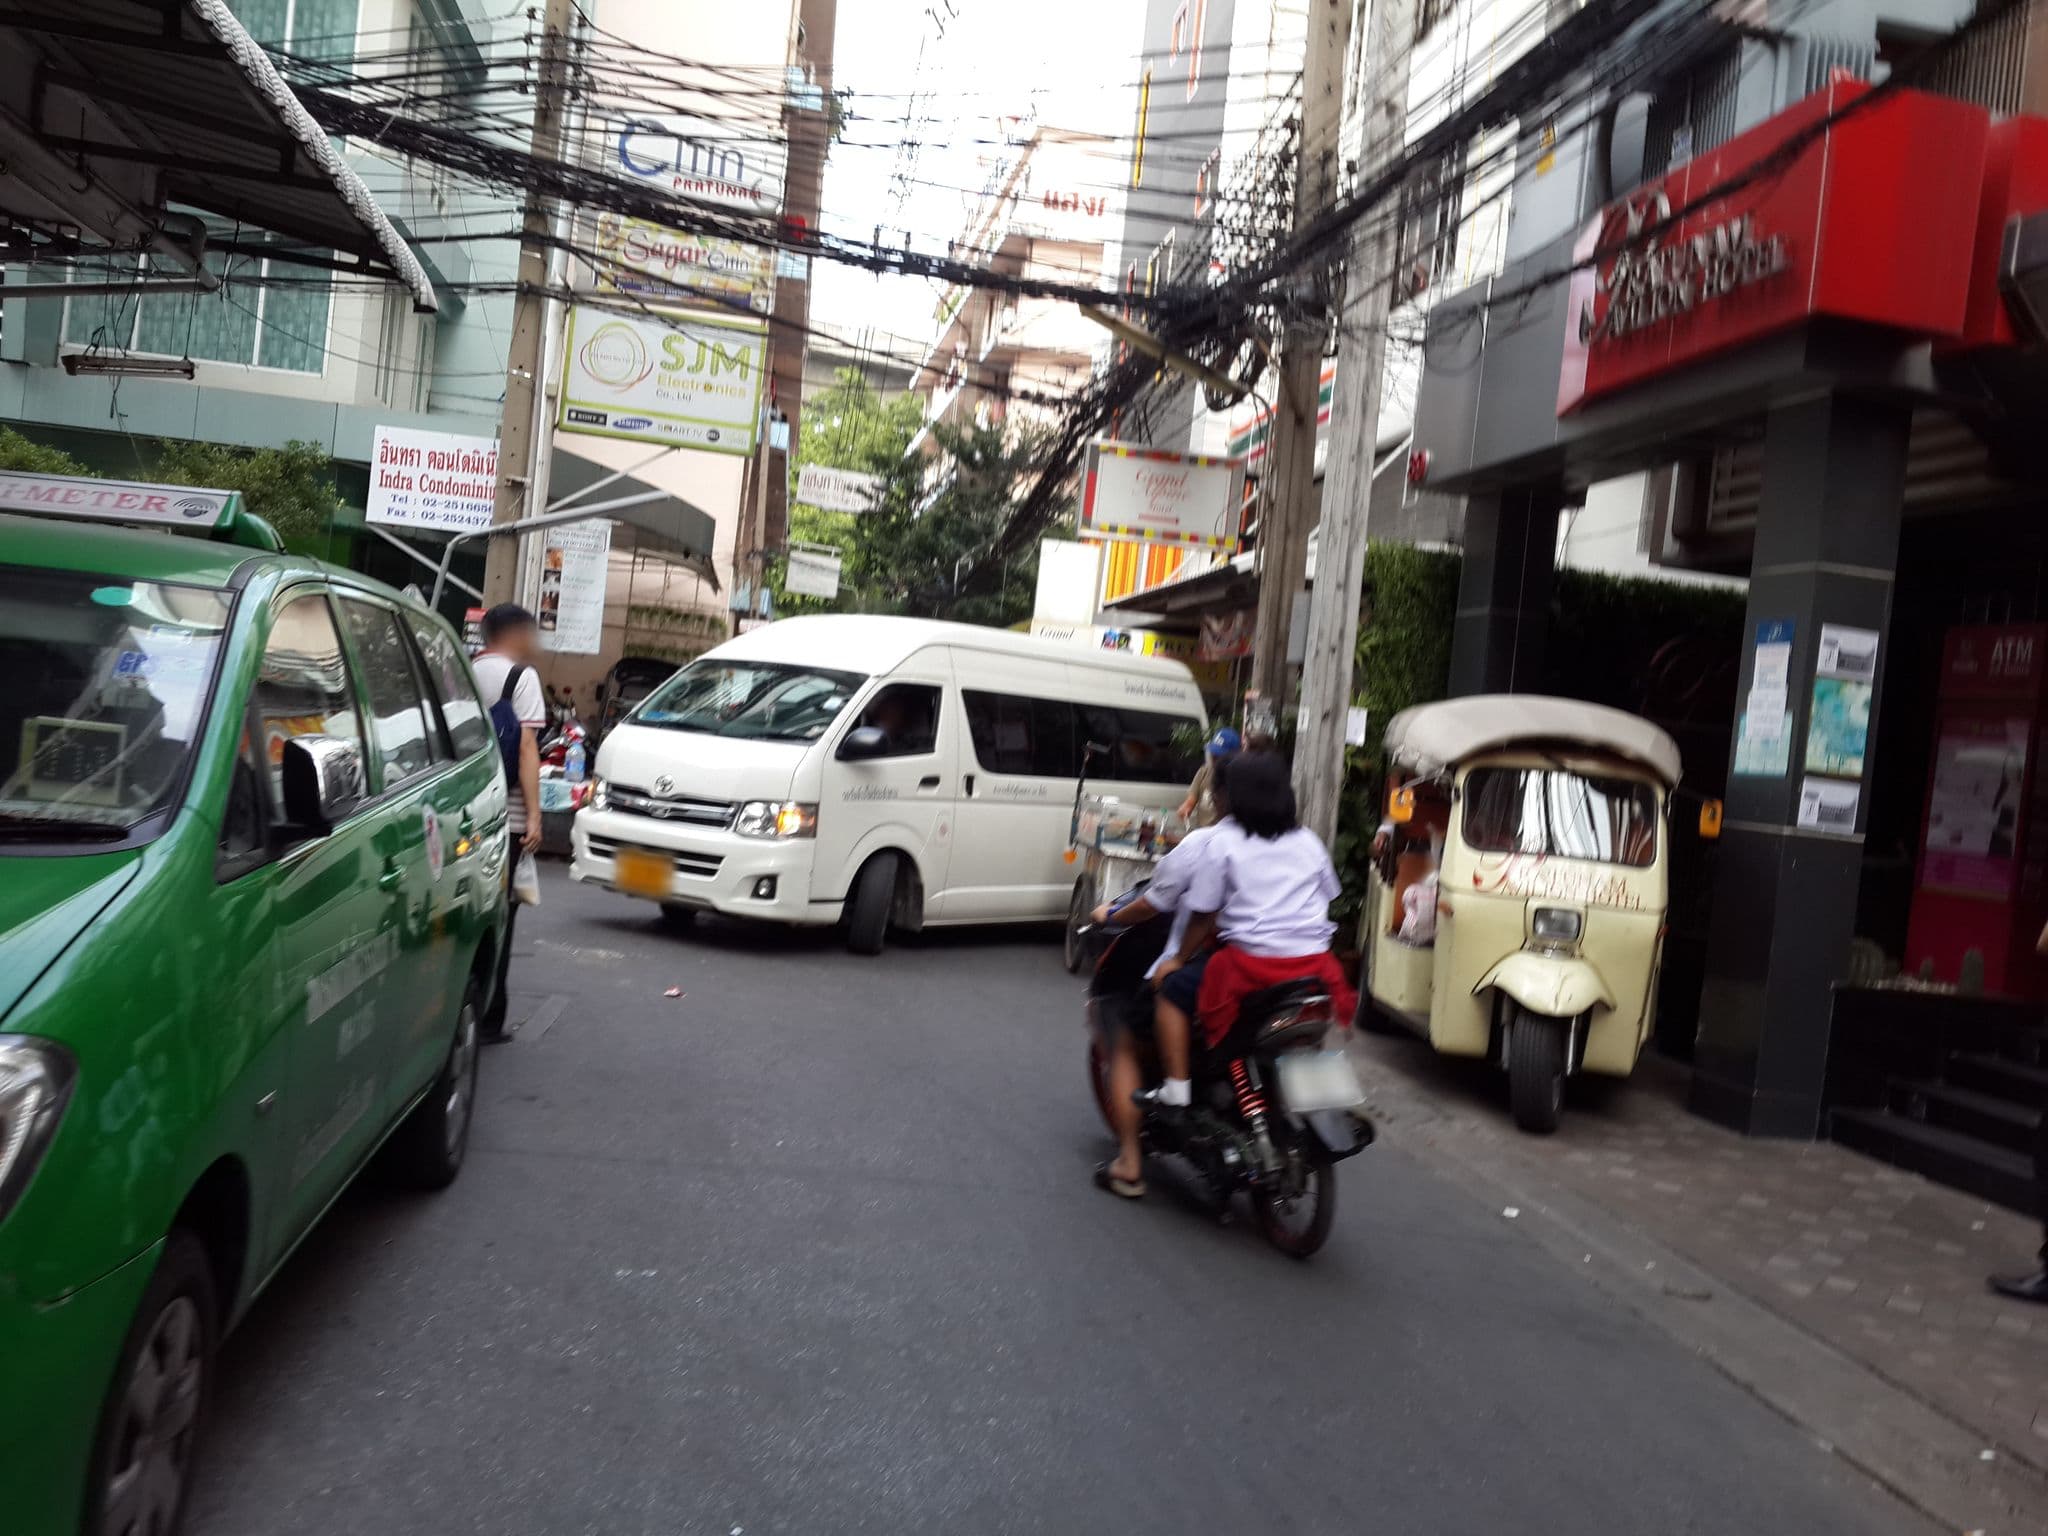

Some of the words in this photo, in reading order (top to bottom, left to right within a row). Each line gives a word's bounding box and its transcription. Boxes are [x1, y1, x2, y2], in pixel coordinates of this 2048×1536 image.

[672, 176, 762, 200] PRATUNAM
[660, 334, 751, 381] SJM
[656, 373, 747, 398] Electronics
[379, 438, 421, 468] อินทรา
[427, 448, 497, 477] คอนโดมิเนี
[378, 468, 413, 491] Indra
[419, 473, 496, 501] Condominiu
[385, 506, 407, 517] Fax
[390, 494, 408, 505] Tel
[1990, 636, 2034, 665] ATM
